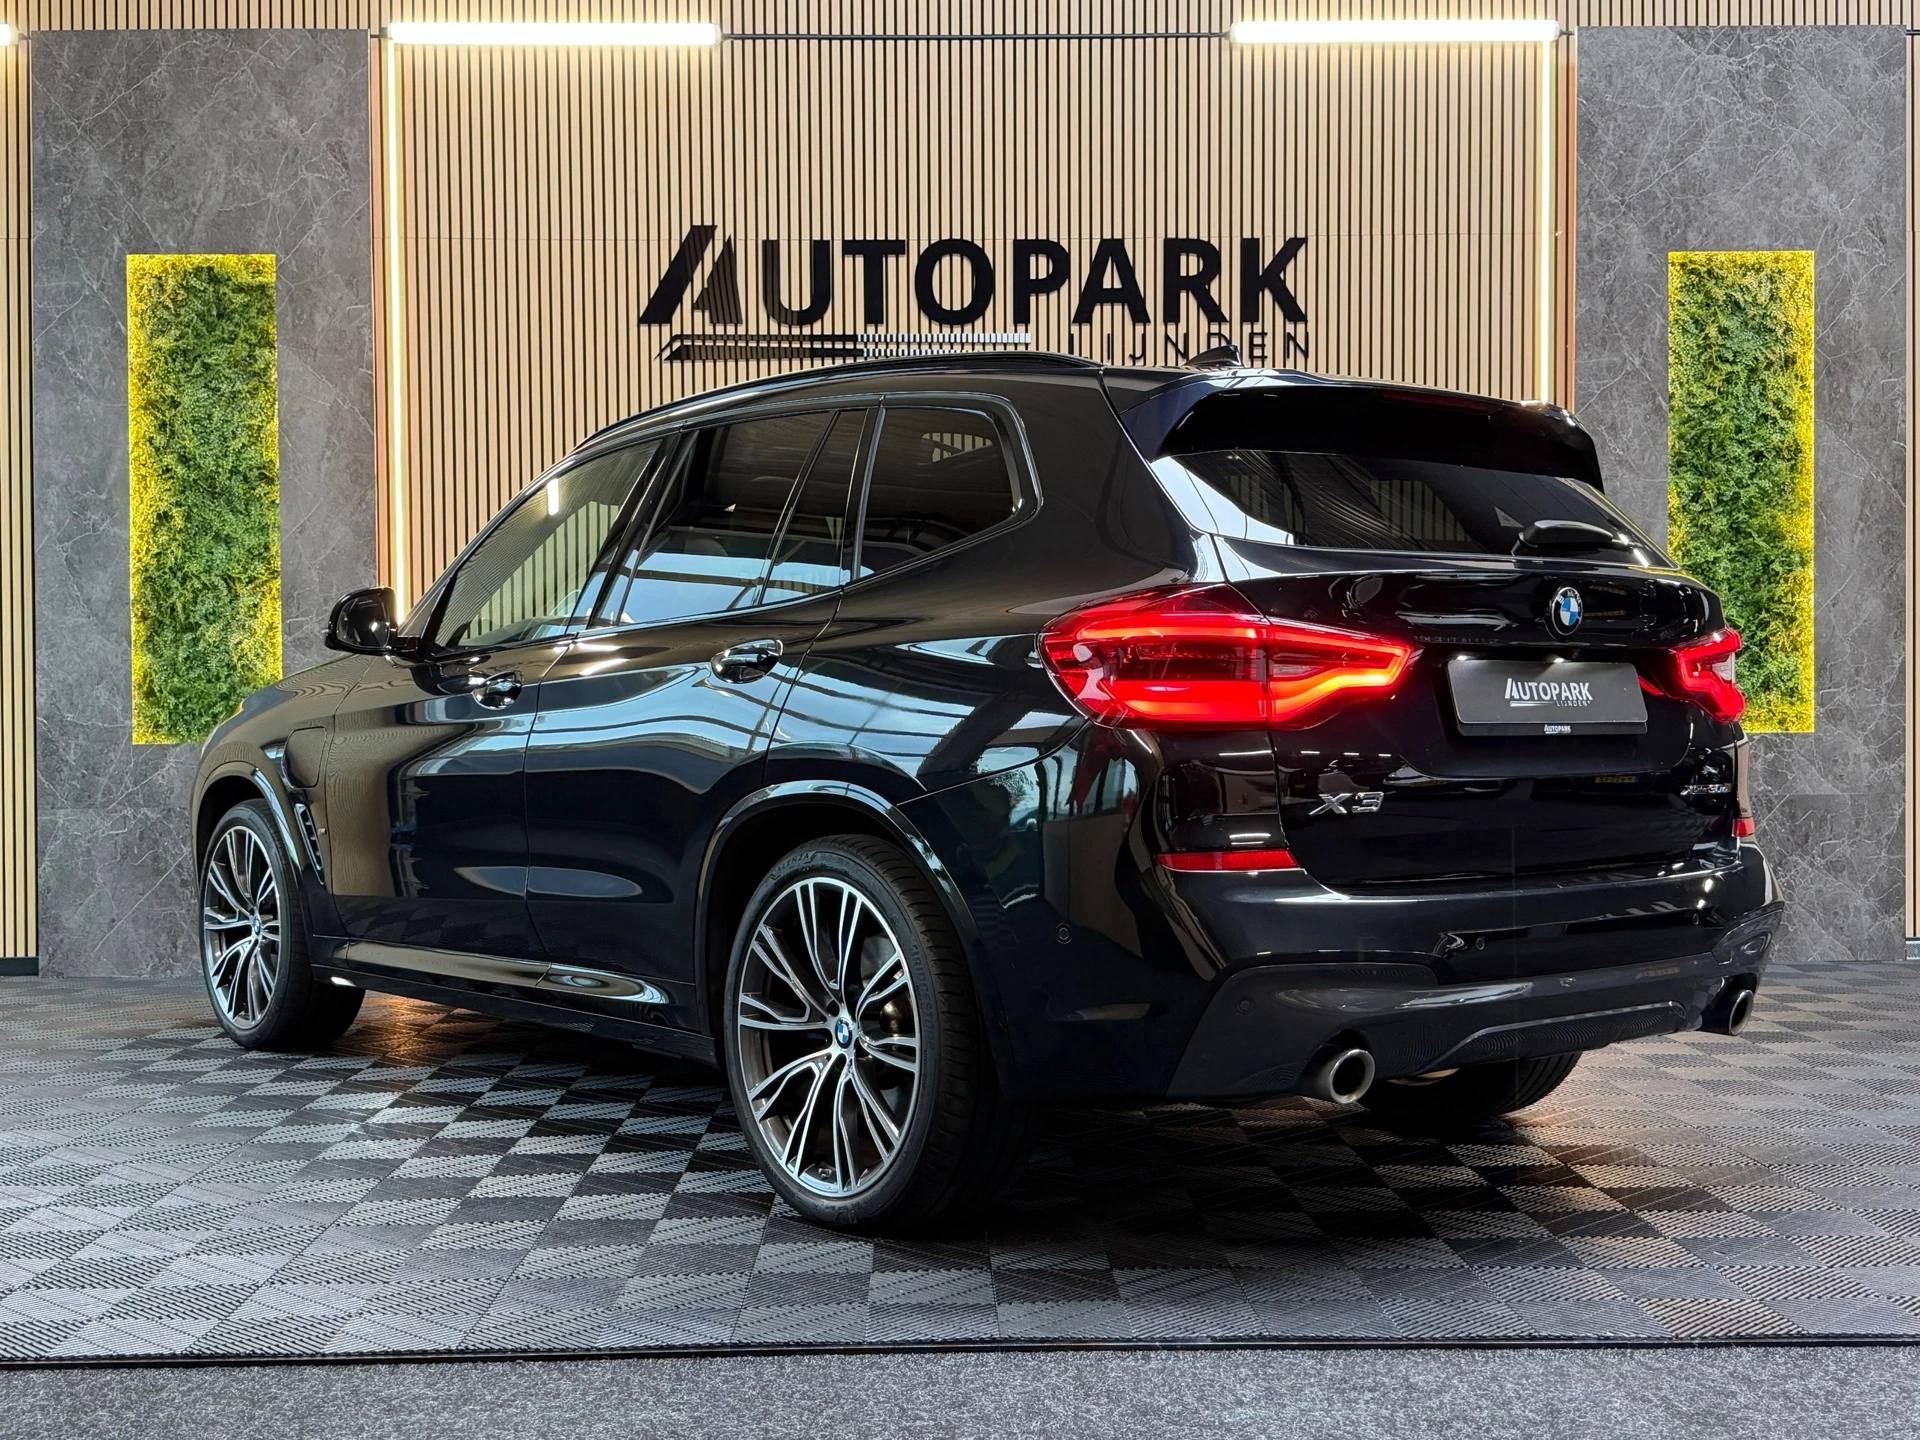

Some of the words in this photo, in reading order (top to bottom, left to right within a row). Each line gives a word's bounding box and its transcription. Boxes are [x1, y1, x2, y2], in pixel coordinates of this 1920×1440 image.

[637, 224, 1308, 325] AUTOPARK
[1504, 678, 1593, 701] AUTOPARK
[1309, 791, 1385, 815] X3
[776, 853, 810, 873] ALENZA
